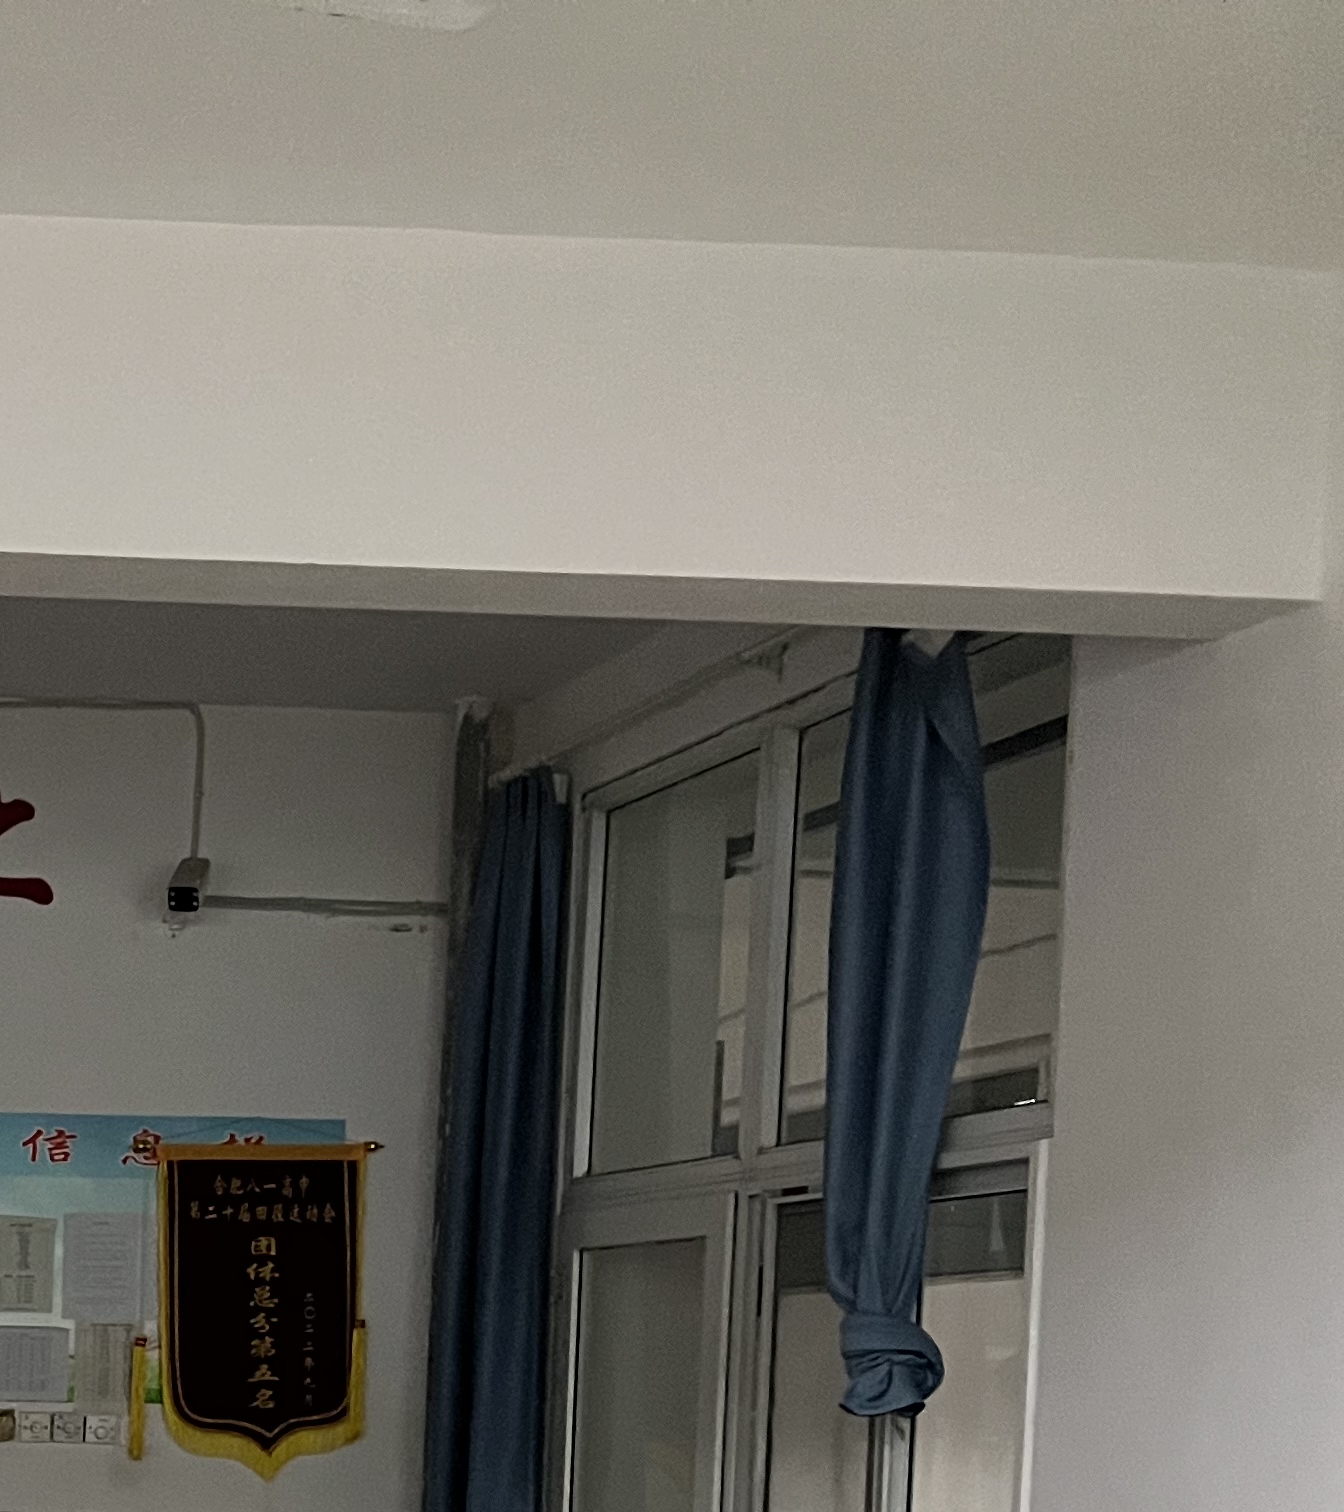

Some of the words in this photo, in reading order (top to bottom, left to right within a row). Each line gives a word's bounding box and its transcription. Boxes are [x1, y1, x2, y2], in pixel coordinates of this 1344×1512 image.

[246, 1236, 280, 1409] 团体总分第五名
